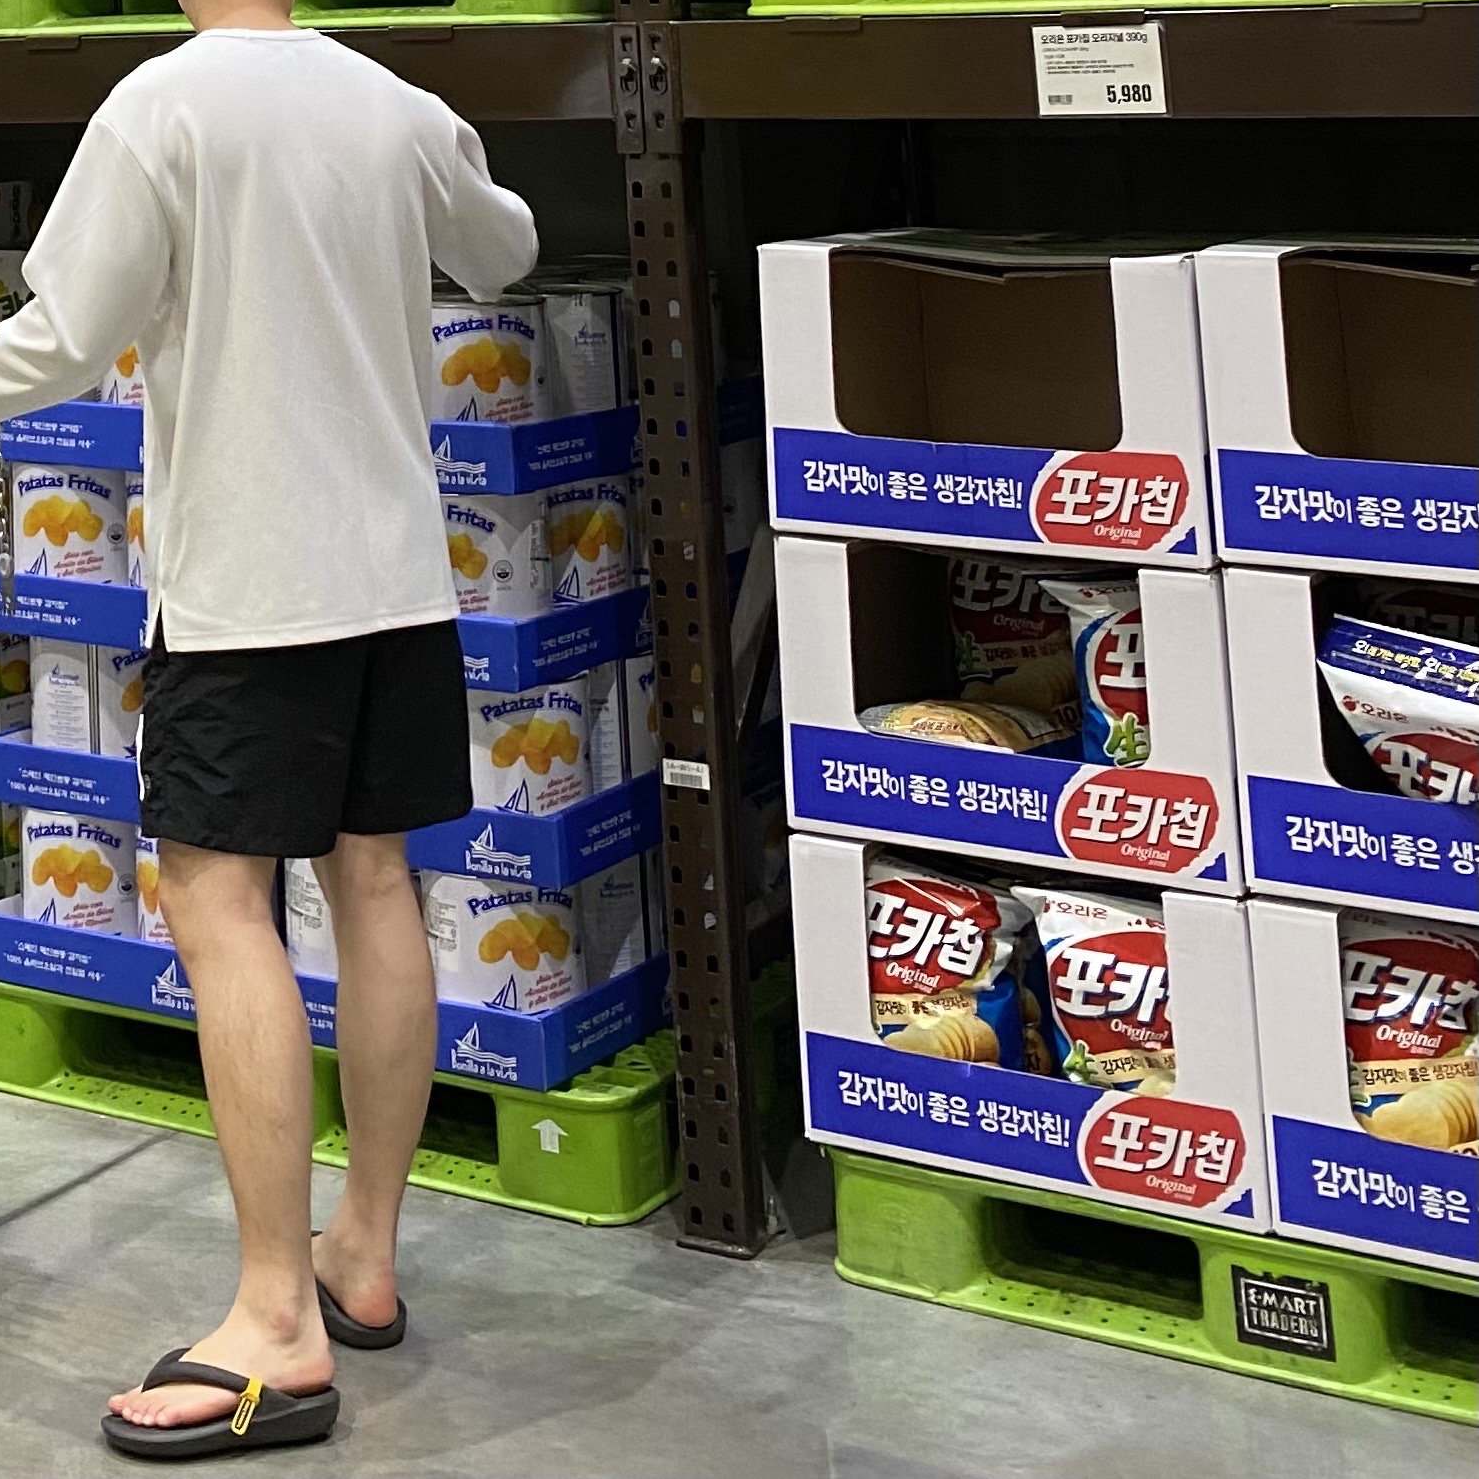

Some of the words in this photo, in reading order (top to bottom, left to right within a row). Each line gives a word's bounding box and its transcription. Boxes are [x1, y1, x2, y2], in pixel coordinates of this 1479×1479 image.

[1106, 84, 1152, 104] 5,980
[432, 315, 493, 343] Patatas
[498, 315, 536, 341] Fritas
[18, 475, 64, 497] Patatas
[68, 474, 111, 499] Fritas
[803, 459, 885, 497] 감자맛이
[887, 471, 927, 501] 좋은
[933, 477, 1023, 510] 생감자칩!
[1043, 467, 1181, 526] 포카칩
[446, 504, 495, 535] Fritas
[1255, 485, 1352, 523] 감자맛이
[1355, 497, 1405, 529] 좋은
[1093, 524, 1143, 540] Original
[480, 692, 545, 722] Patatas
[821, 759, 906, 800] 감자맛이
[907, 774, 950, 808] 좋은
[956, 779, 1048, 823] 생감자칩!
[1069, 782, 1212, 849] 포카칩
[27, 821, 74, 842] Patatas
[77, 823, 122, 849] Fritas
[1286, 815, 1387, 862] 감자맛이
[1390, 833, 1441, 870] 좋은
[1120, 843, 1171, 862] Original
[467, 889, 533, 918] Patatas
[1055, 901, 1108, 920] 오리온
[885, 961, 940, 989] Original
[1109, 1017, 1171, 1043] Original
[1376, 1023, 1442, 1050] Original
[1362, 1068, 1408, 1085] 감자맛이
[1409, 1066, 1431, 1082] 좋은
[838, 1070, 924, 1118] 감자맛이
[927, 1092, 971, 1127] 좋은
[976, 1100, 1071, 1148] 생감자칩!
[1093, 1109, 1239, 1184] 포카칩
[1145, 1173, 1197, 1197] Original
[1312, 1158, 1415, 1212] 감자맛이
[1419, 1183, 1471, 1224] 좋은
[1251, 1306, 1319, 1339] TRADERS
